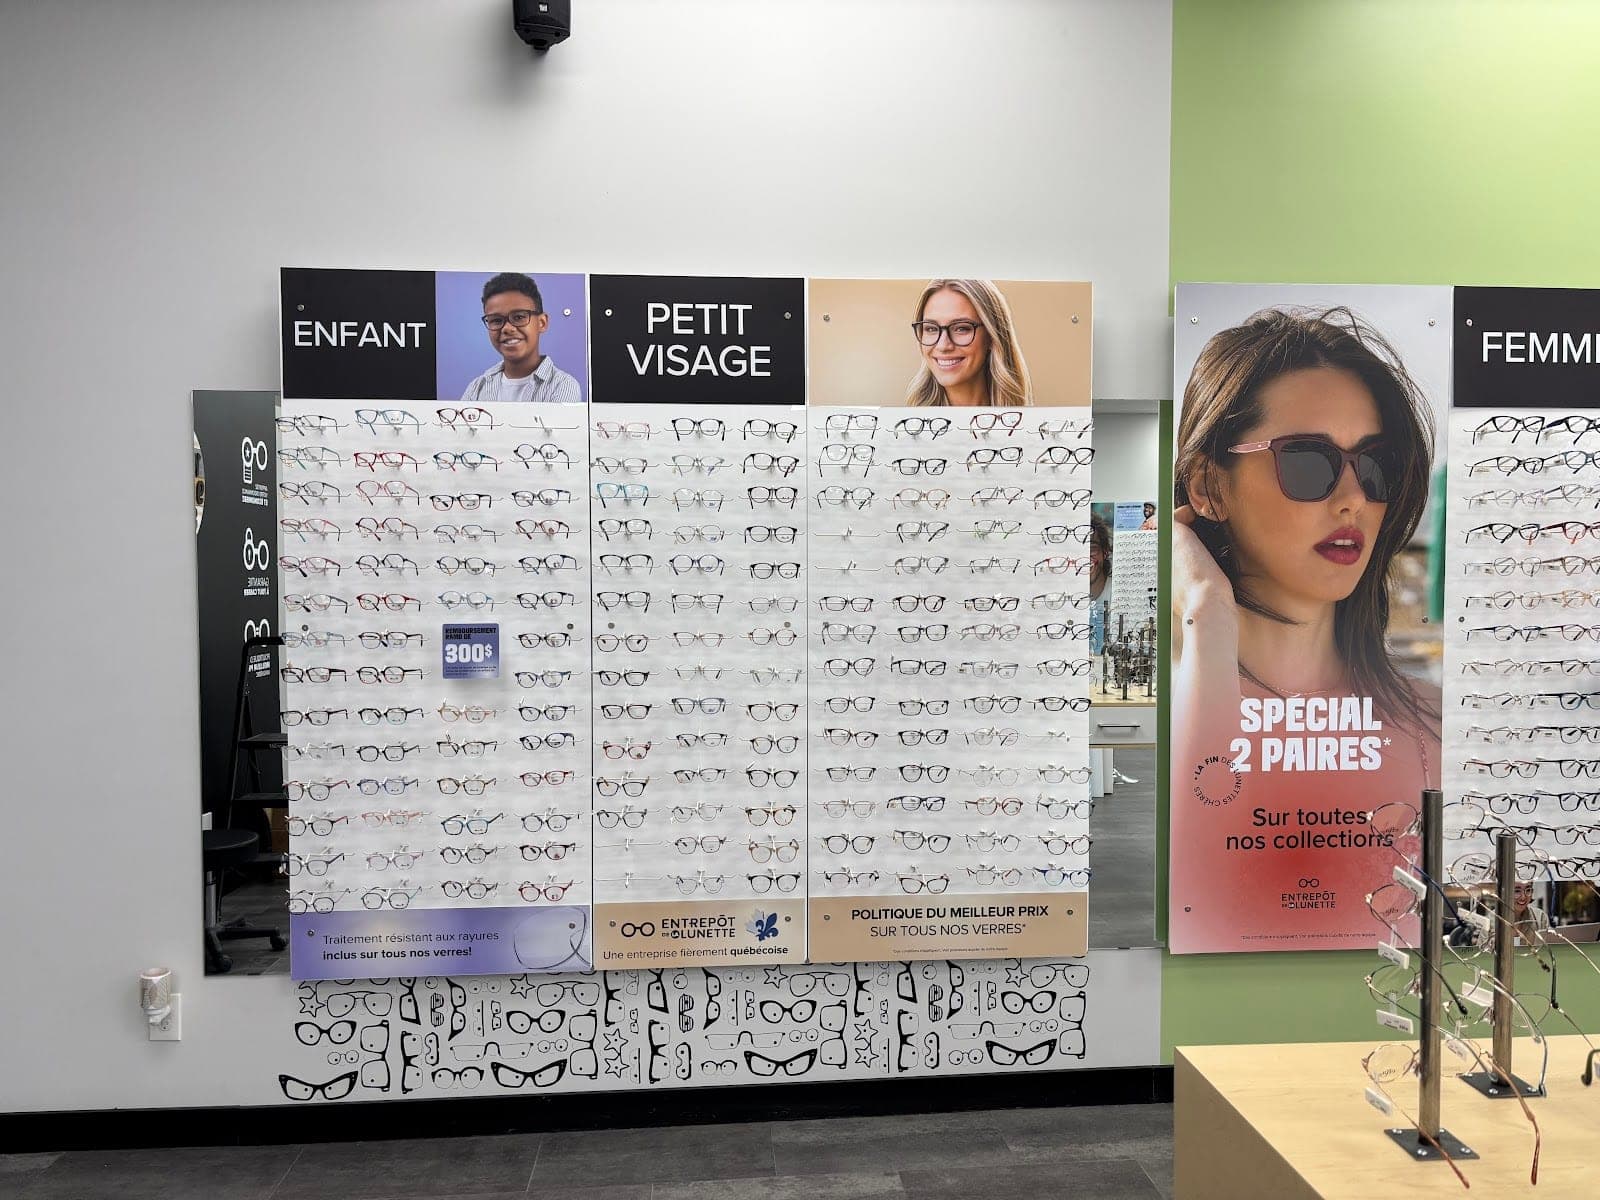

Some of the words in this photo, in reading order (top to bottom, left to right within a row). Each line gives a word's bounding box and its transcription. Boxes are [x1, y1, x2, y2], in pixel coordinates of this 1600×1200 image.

[647, 302, 753, 335] PETIT
[294, 320, 427, 348] ENFANT
[1482, 331, 1600, 364] FEMM
[626, 343, 771, 377] VISAGE
[445, 643, 493, 663] 300$
[1229, 737, 1252, 772] 2
[1194, 764, 1205, 775] LA
[1204, 755, 1219, 766] FIN
[1220, 756, 1236, 769] DES
[1252, 807, 1290, 827] Sur
[1296, 807, 1368, 826] toutes
[1226, 833, 1266, 850] nos
[1273, 829, 1394, 849] collections
[661, 914, 736, 929] ENTREPÔT
[851, 907, 923, 920] POLITIQUE
[926, 907, 946, 919] DU
[950, 906, 1015, 918] MEILLEUR
[1018, 905, 1049, 917] PRIX
[323, 934, 382, 945] Traitement
[385, 933, 433, 943] résistant
[435, 934, 455, 942] aux
[458, 931, 500, 943] rayures
[681, 928, 736, 939] LUNETTE
[870, 926, 897, 937] SUR
[900, 925, 937, 936] TOUS
[940, 924, 969, 935] NOS
[323, 950, 357, 960] inclus
[360, 950, 378, 959] sur
[381, 949, 407, 959] tous
[409, 949, 430, 957] nos
[433, 947, 472, 957] verres!
[602, 950, 625, 960] Une
[626, 949, 678, 961] entreprise
[680, 947, 728, 958] fièrement
[730, 945, 789, 958] québécoise
